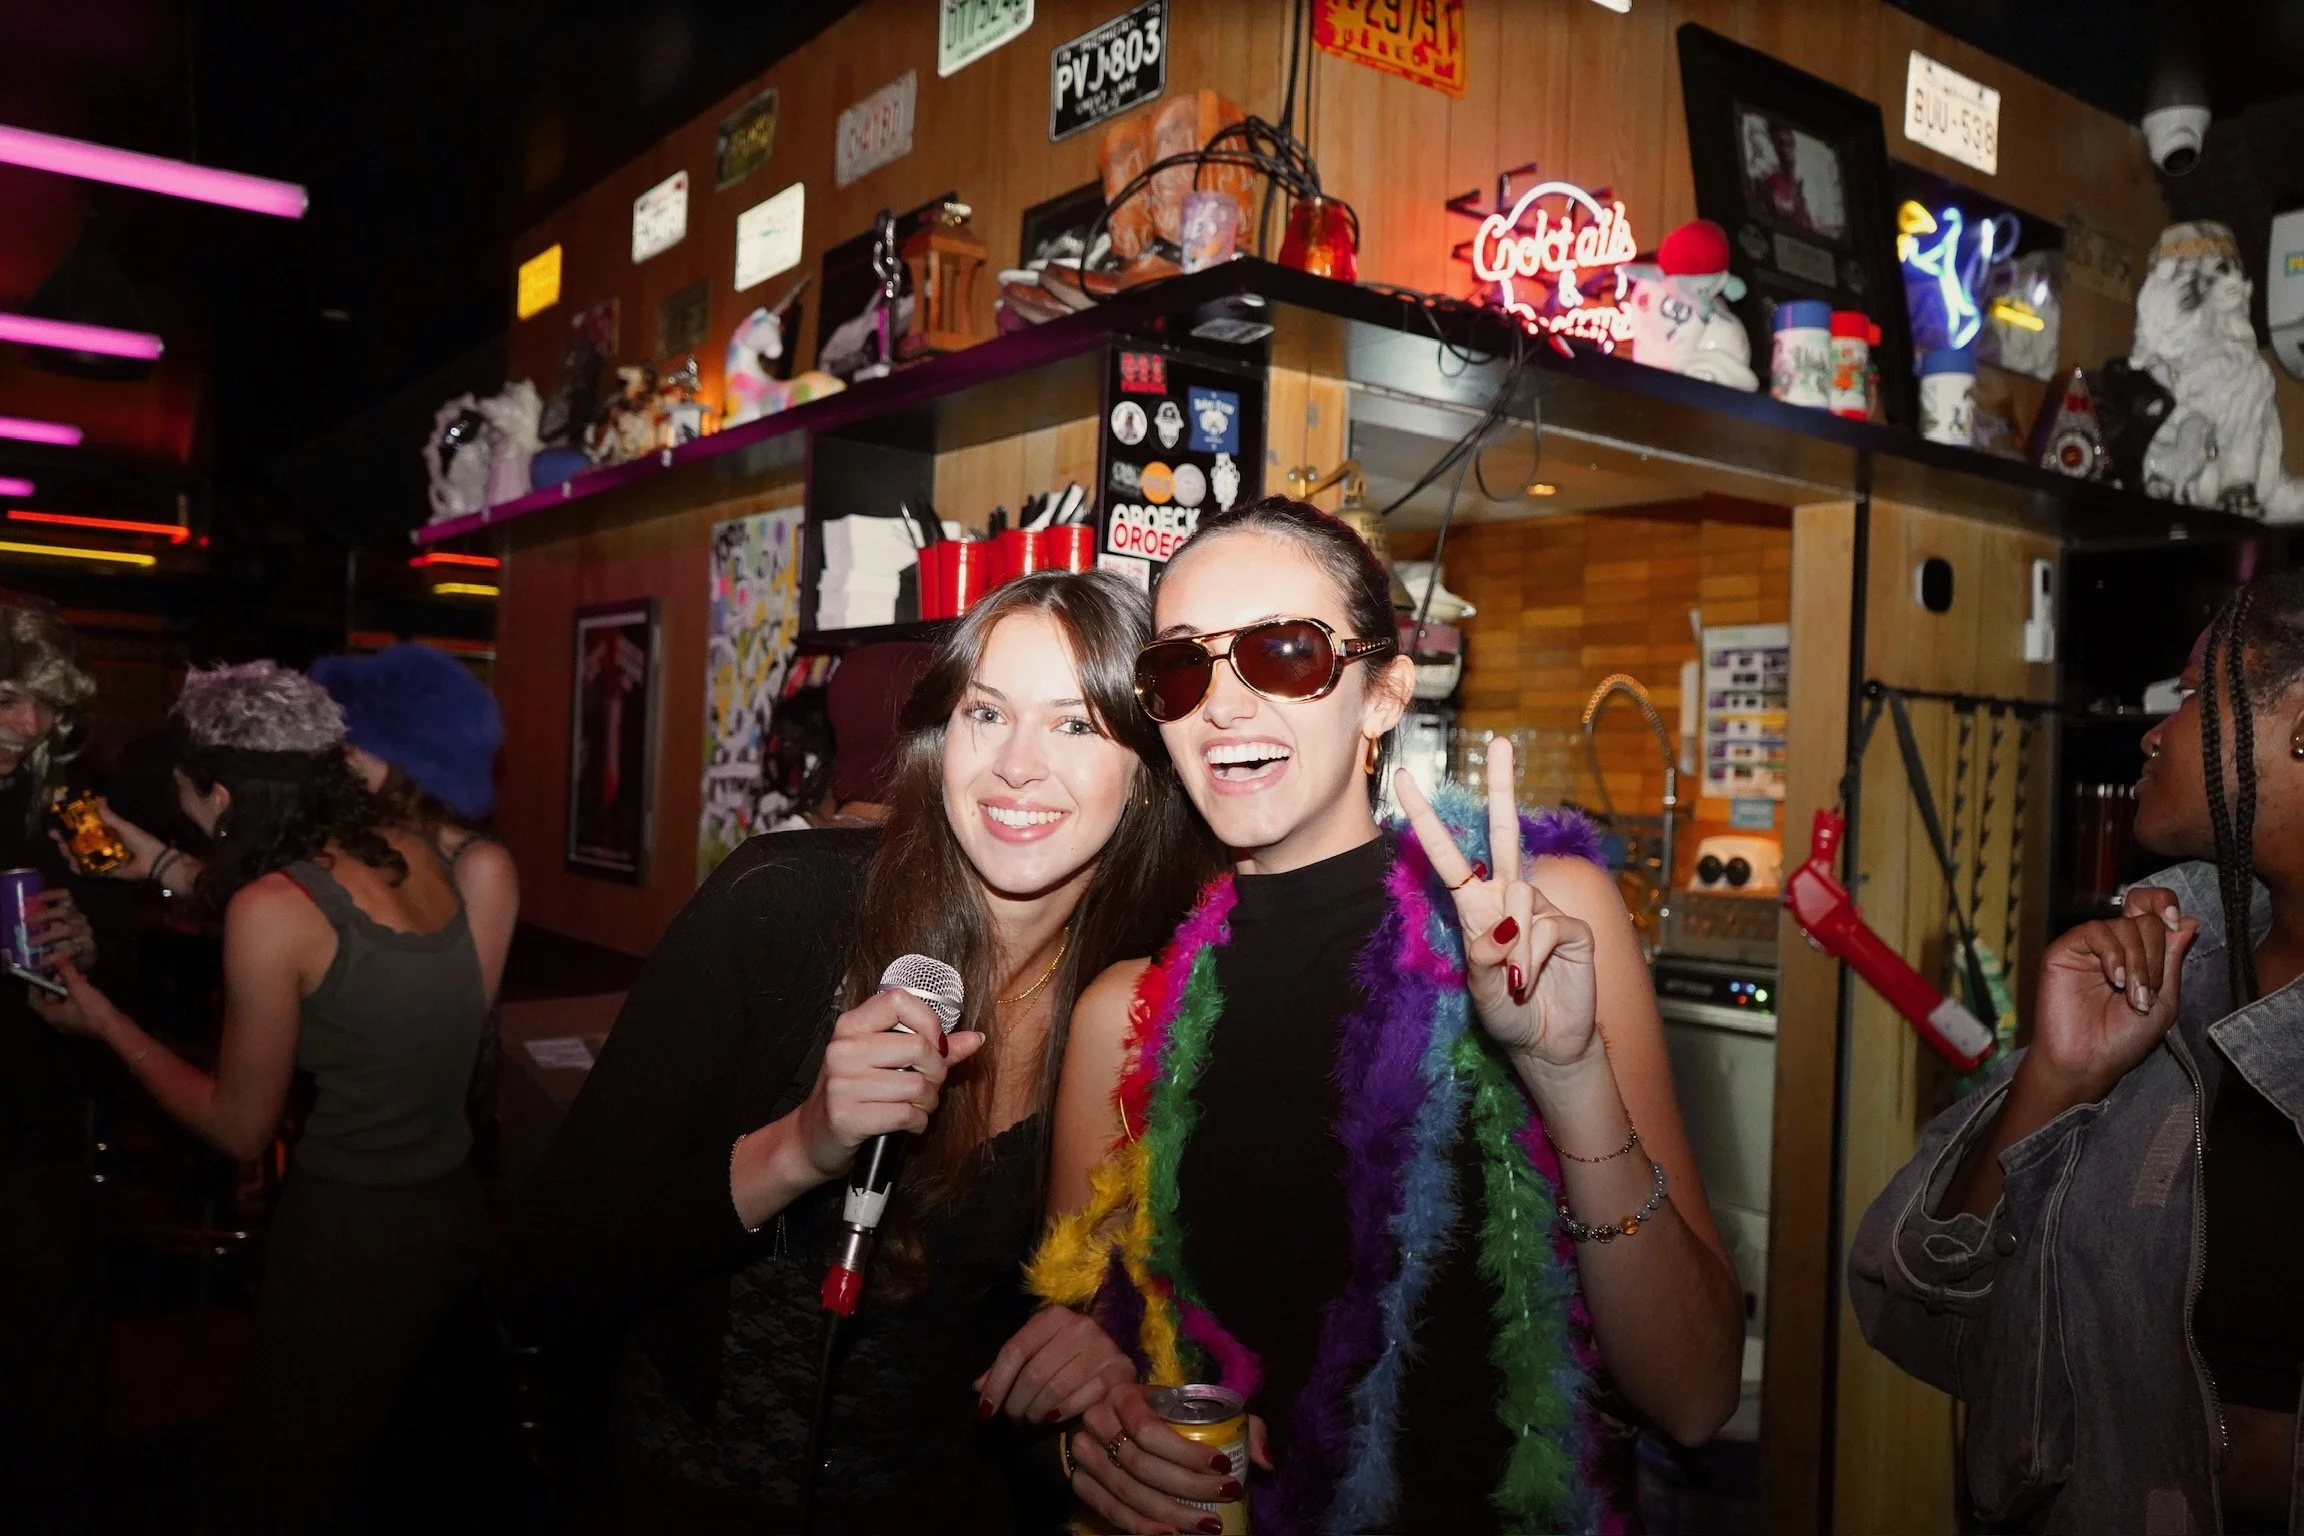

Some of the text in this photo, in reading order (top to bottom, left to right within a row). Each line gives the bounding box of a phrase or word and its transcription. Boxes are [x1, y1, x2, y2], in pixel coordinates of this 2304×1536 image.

[1056, 16, 1161, 112] PVJ-803
[1473, 201, 1637, 281] Cocktails
[1114, 522, 1184, 557] OROEC
